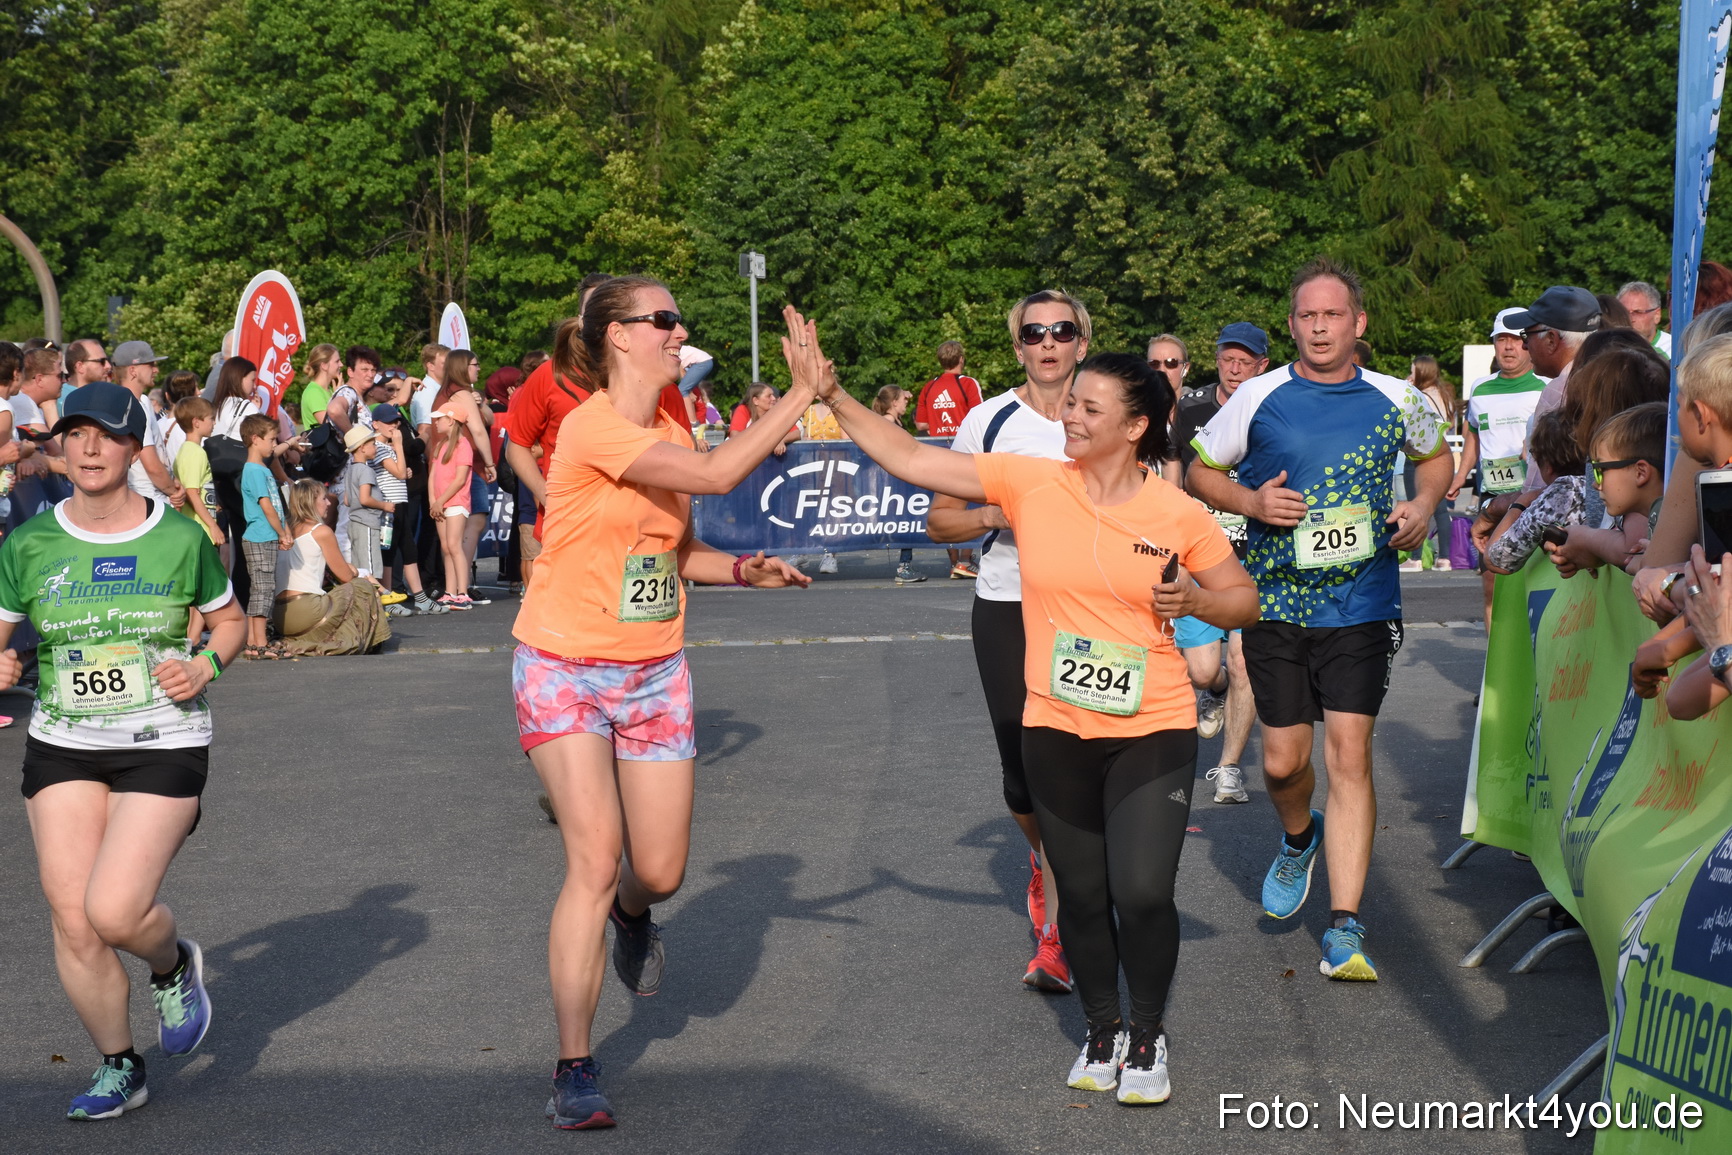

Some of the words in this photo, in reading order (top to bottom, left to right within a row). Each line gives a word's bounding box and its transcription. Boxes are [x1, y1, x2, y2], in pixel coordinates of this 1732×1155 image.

[252, 294, 267, 325] AVIA
[932, 400, 956, 409] adidas
[1489, 468, 1514, 481] 114
[1312, 525, 1357, 551] 205
[1132, 543, 1171, 559] THULE
[1337, 546, 1360, 555] Torsten
[101, 566, 134, 574] Fischer
[69, 577, 176, 599] firmenlauf
[630, 574, 676, 603] 2319
[68, 596, 114, 605] neumarkt
[635, 603, 664, 611] Weymouth
[41, 611, 100, 632] Gesunde
[107, 607, 163, 621] Firmen
[67, 626, 113, 642] laufen
[119, 620, 170, 640] länger!
[121, 658, 140, 666] 2019
[1123, 663, 1141, 671] 2019
[72, 668, 126, 696] 568
[1059, 658, 1131, 695] 2294
[106, 692, 133, 701] Sandra
[1061, 683, 1089, 696] Garthoff
[1090, 691, 1127, 703] Stephanie
